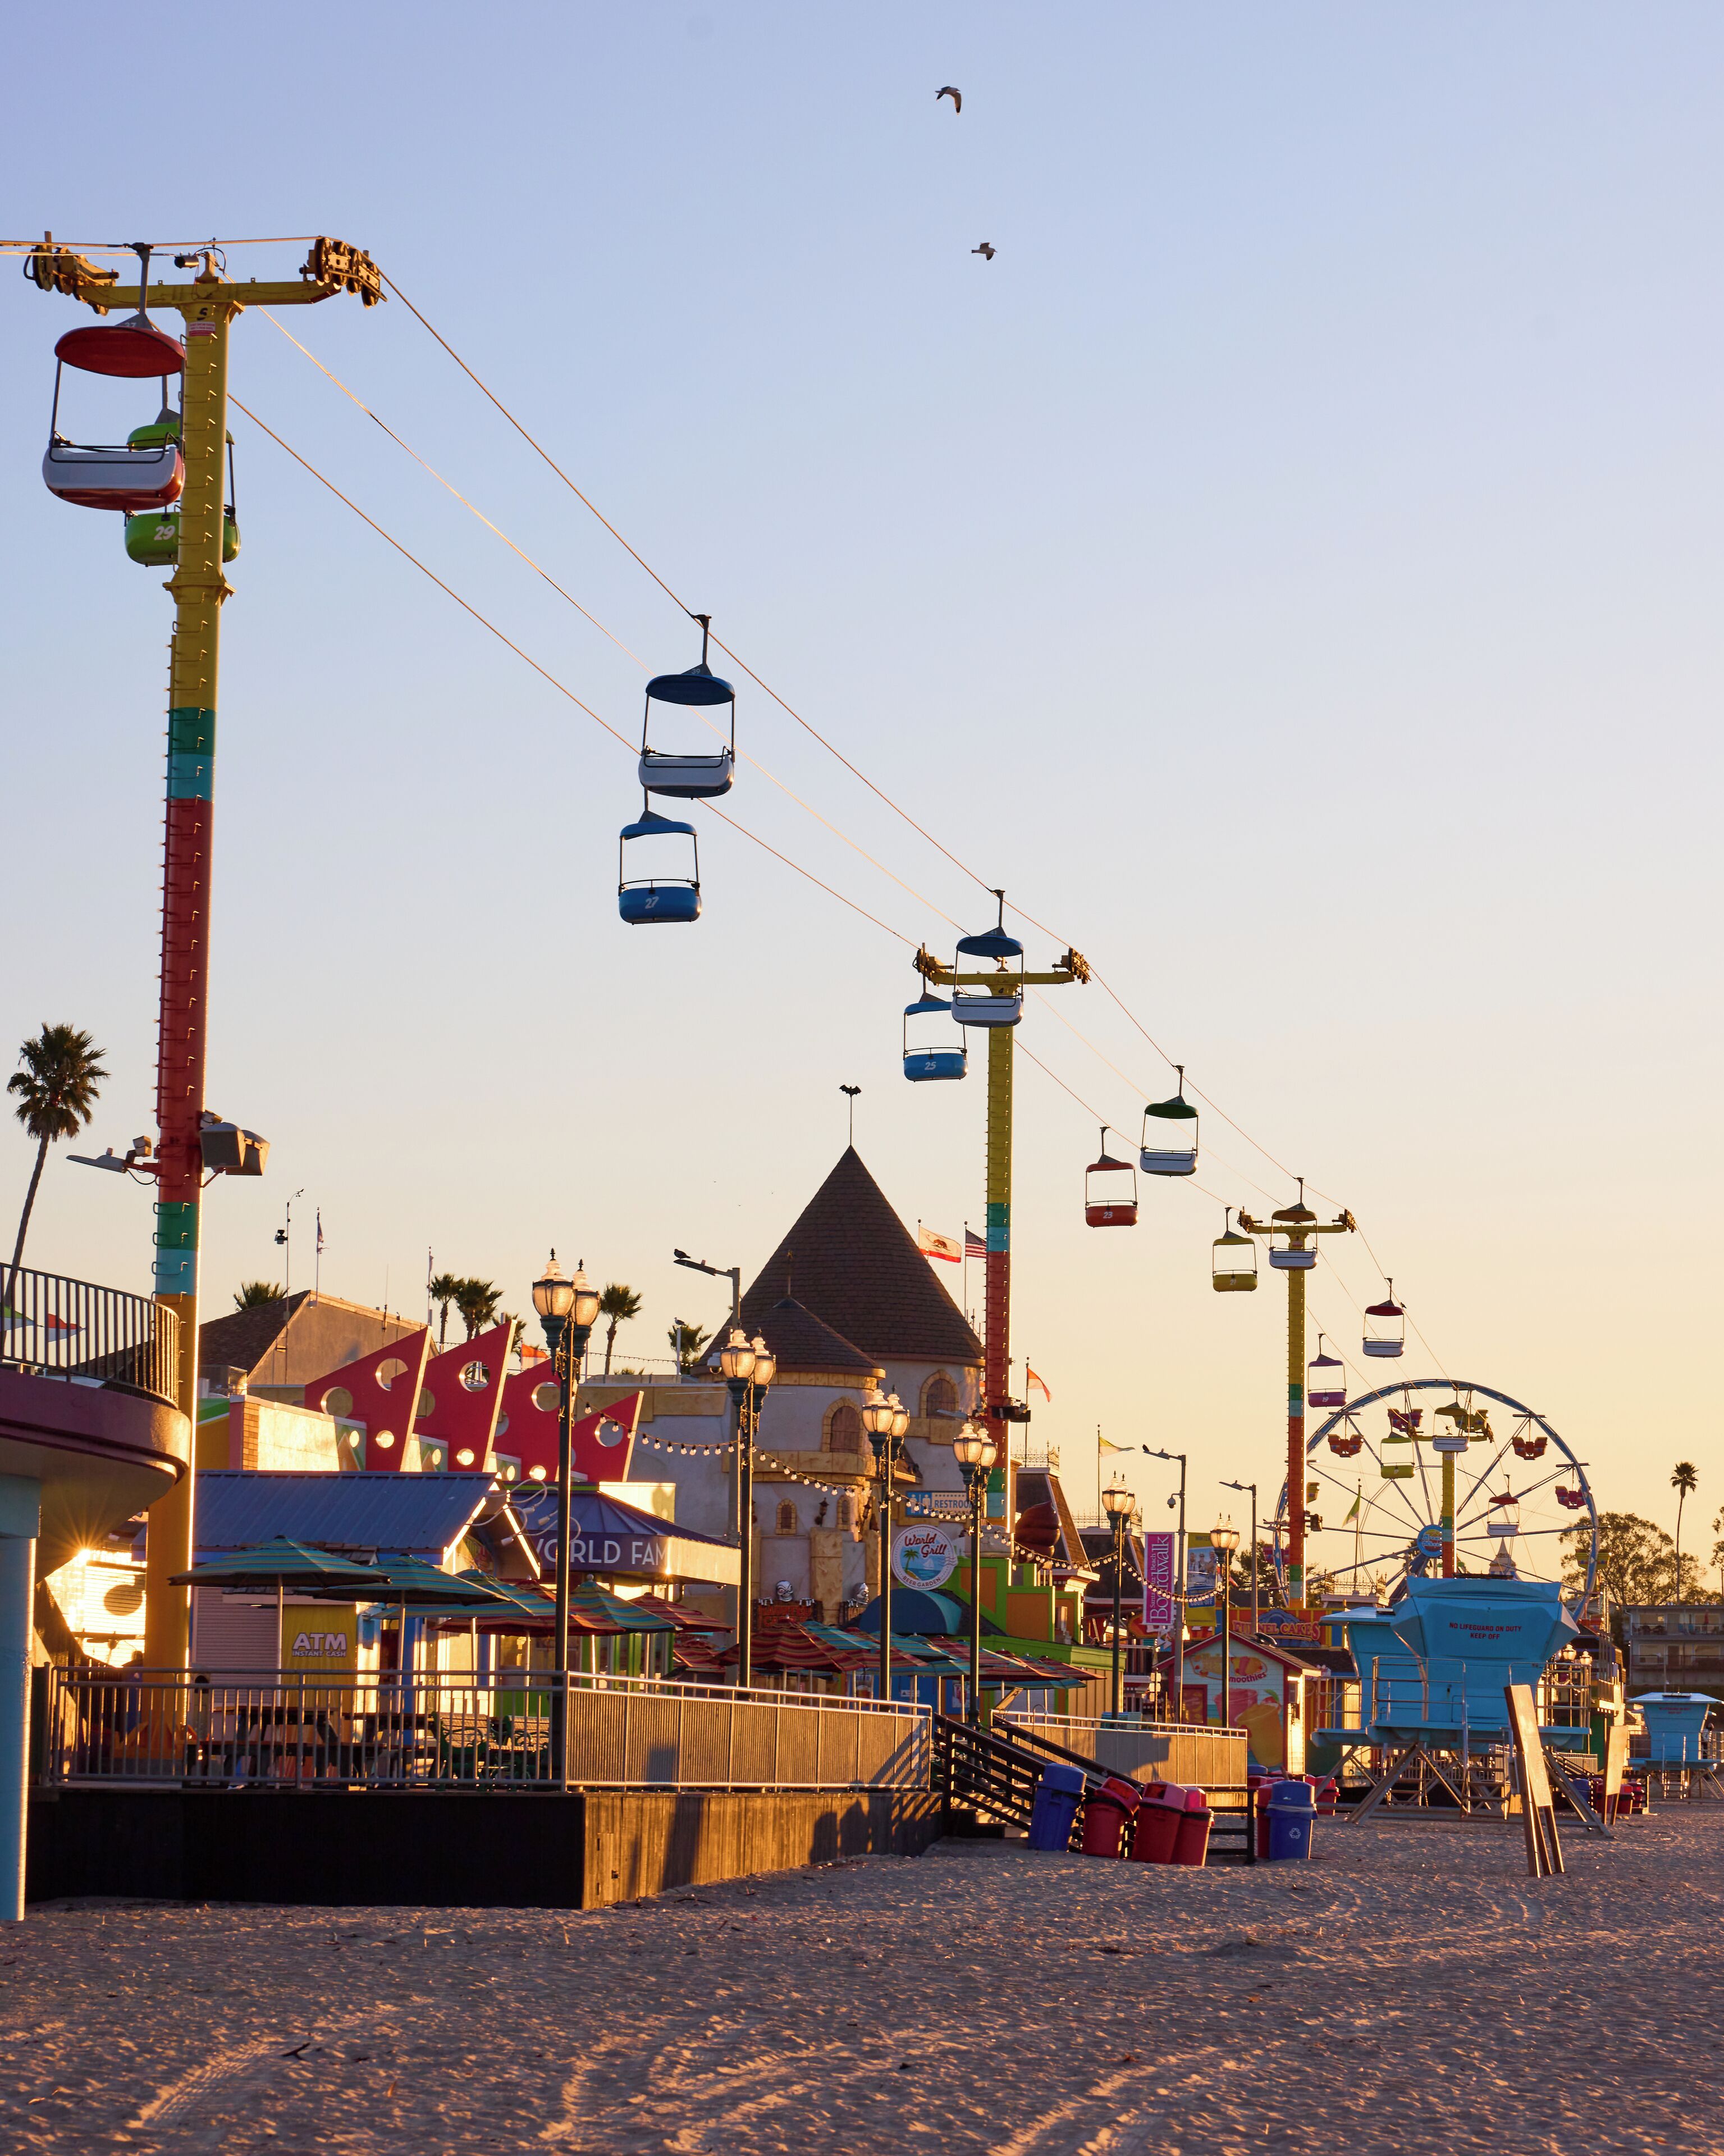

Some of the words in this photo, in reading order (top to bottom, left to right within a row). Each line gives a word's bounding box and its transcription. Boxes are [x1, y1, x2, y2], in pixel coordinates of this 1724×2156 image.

[154, 525, 176, 541] 29
[645, 896, 660, 909] 27
[924, 1062, 936, 1070] 25
[904, 1533, 937, 1546] World
[921, 1544, 947, 1558] Grill
[903, 1576, 917, 1586] BEER
[917, 1577, 941, 1587] GARDEN
[1232, 1620, 1279, 1635] FUNEL
[1280, 1620, 1321, 1641] CAKES
[1460, 1623, 1494, 1632] LIFEGUARD
[292, 1632, 347, 1651] ATM
[1228, 1671, 1267, 1683] moothies
